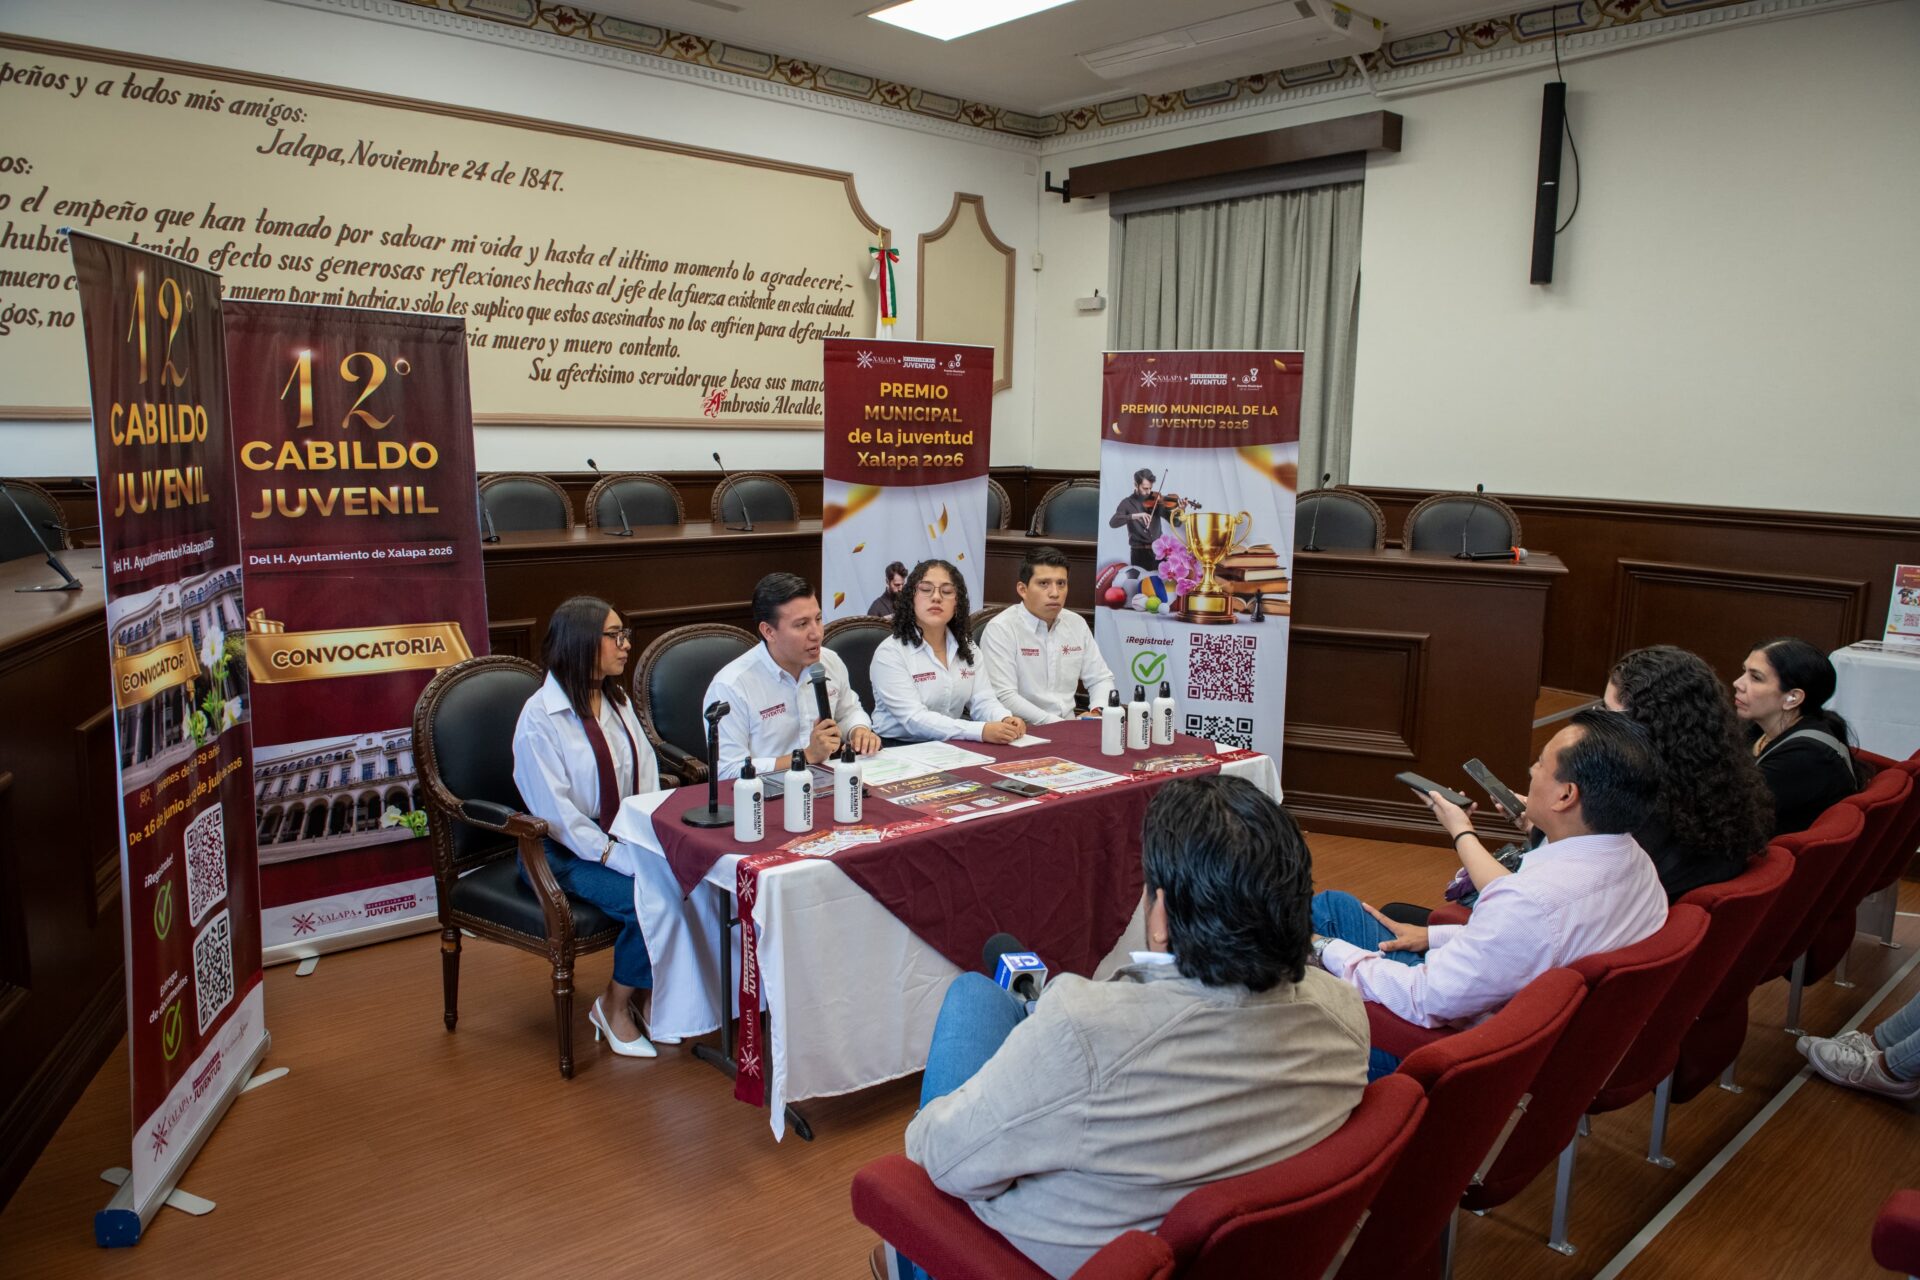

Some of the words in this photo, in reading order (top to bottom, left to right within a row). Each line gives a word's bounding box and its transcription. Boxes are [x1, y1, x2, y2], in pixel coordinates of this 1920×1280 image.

[70, 76, 88, 98] y
[95, 79, 114, 96] a
[121, 72, 182, 105] todos
[184, 89, 224, 112] mis
[228, 97, 308, 126] amigos:
[256, 128, 345, 166] Jalapa,
[347, 139, 460, 178] Noviembre
[461, 160, 490, 181] 24
[491, 161, 516, 185] de
[519, 166, 564, 192] 1847.
[20, 185, 49, 213] el
[53, 199, 148, 227] empeño
[154, 208, 195, 233] que
[199, 202, 246, 232] han
[254, 207, 332, 240] tomado
[334, 223, 374, 247] por
[380, 223, 446, 251] salvar
[450, 234, 479, 254] mi
[480, 235, 523, 259] vida
[523, 246, 540, 267] y
[544, 238, 596, 266] hasta
[598, 246, 618, 267] el
[673, 259, 739, 280] momento
[742, 262, 755, 281] lo
[0, 221, 70, 253] hubie
[208, 241, 272, 272] efecto
[277, 253, 314, 272] sus
[316, 256, 425, 282] generosas
[431, 262, 531, 290] reflexiones
[533, 269, 595, 295] hechas
[596, 275, 616, 296] al
[611, 278, 646, 305] jefe
[648, 280, 667, 301] de
[668, 282, 684, 302] la
[678, 283, 726, 308] fuerza
[727, 290, 776, 311] existente
[777, 300, 790, 312] en
[792, 295, 814, 315] esta
[816, 298, 855, 318] ciudad.
[229, 285, 286, 301] muero
[322, 287, 345, 306] mi
[411, 291, 444, 314] sólo
[446, 293, 469, 315] les
[471, 296, 524, 323] suplico
[526, 306, 552, 326] que
[554, 303, 590, 324] estos
[592, 307, 665, 330] asesinatos
[668, 317, 684, 331] no
[688, 311, 707, 332] los
[754, 321, 786, 341] para
[47, 310, 75, 327] no
[492, 333, 546, 351] muero
[547, 338, 559, 357] y
[563, 336, 613, 355] muero
[619, 336, 681, 358] contento.
[528, 357, 552, 382] Su
[639, 366, 702, 387] servidor
[701, 374, 727, 397] que
[730, 369, 762, 390] besa
[765, 376, 787, 390] sus
[790, 378, 825, 393] mano
[903, 362, 936, 370] JUVENTUD
[703, 389, 770, 418] Ambrosio
[773, 395, 823, 415] Alcalde.
[880, 382, 948, 399] PREMIO
[111, 403, 209, 447] CABILDO
[864, 405, 963, 422] MUNICIPAL
[1121, 404, 1168, 414] PREMIO
[1171, 404, 1239, 415] MUNICIPAL
[1242, 405, 1259, 415] DE
[1262, 405, 1278, 416] LA
[1149, 418, 1216, 429] JUVENTUD
[1219, 419, 1249, 429] 2026
[848, 428, 871, 443] de
[876, 428, 893, 444] la
[895, 429, 973, 447] juventud
[240, 440, 439, 471] CABILDO
[857, 451, 918, 470] Xalapa
[923, 453, 964, 467] 2026
[114, 466, 210, 518] JUVENIL
[250, 486, 439, 519] JUVENIL
[123, 557, 133, 571] H.
[134, 547, 178, 572] Ayuntamiento
[250, 554, 271, 565] Del
[273, 554, 286, 564] H.
[288, 550, 369, 567] Ayuntamiento
[371, 549, 385, 559] de
[388, 548, 427, 561] Xalapa
[428, 546, 454, 556] 2026
[272, 637, 446, 669] CONVOCATORIA
[122, 652, 186, 694] CONVOCATOR
[762, 707, 786, 720] JUVENTUD
[129, 832, 142, 845] De
[144, 819, 156, 838] 16
[163, 799, 184, 826] junio
[317, 910, 358, 923] XALAPA
[365, 901, 416, 918] JUVENTUD
[193, 1060, 221, 1103] JUVENTUD
